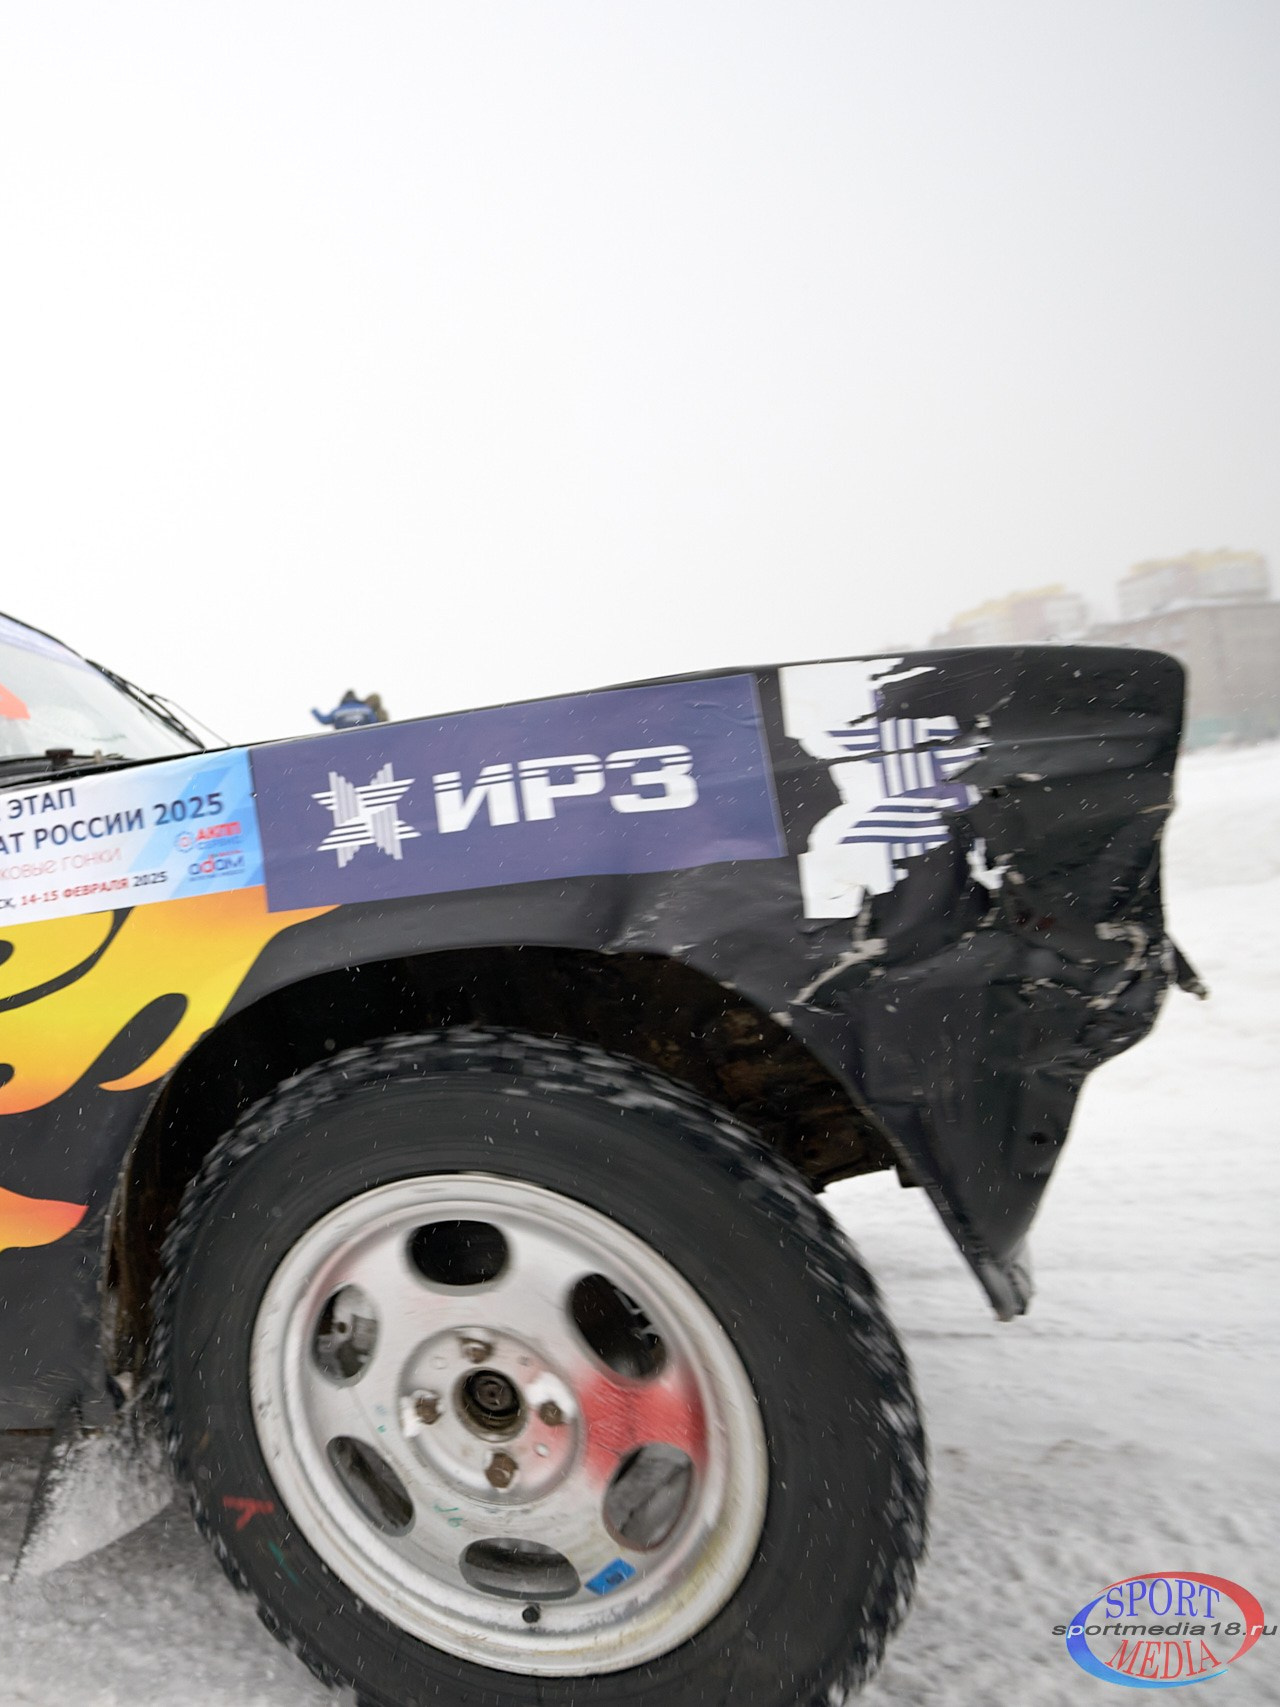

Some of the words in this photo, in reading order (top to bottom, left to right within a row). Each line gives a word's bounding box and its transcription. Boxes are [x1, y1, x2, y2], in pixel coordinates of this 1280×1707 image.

[8, 787, 76, 820] ЭТАП
[432, 744, 699, 834] ИРЗ
[33, 809, 145, 849] РОССИИ
[154, 791, 225, 826] 2025
[20, 889, 59, 906] 14-15
[63, 878, 129, 899] ФЕВРАЛЯ
[132, 871, 168, 888] 2025
